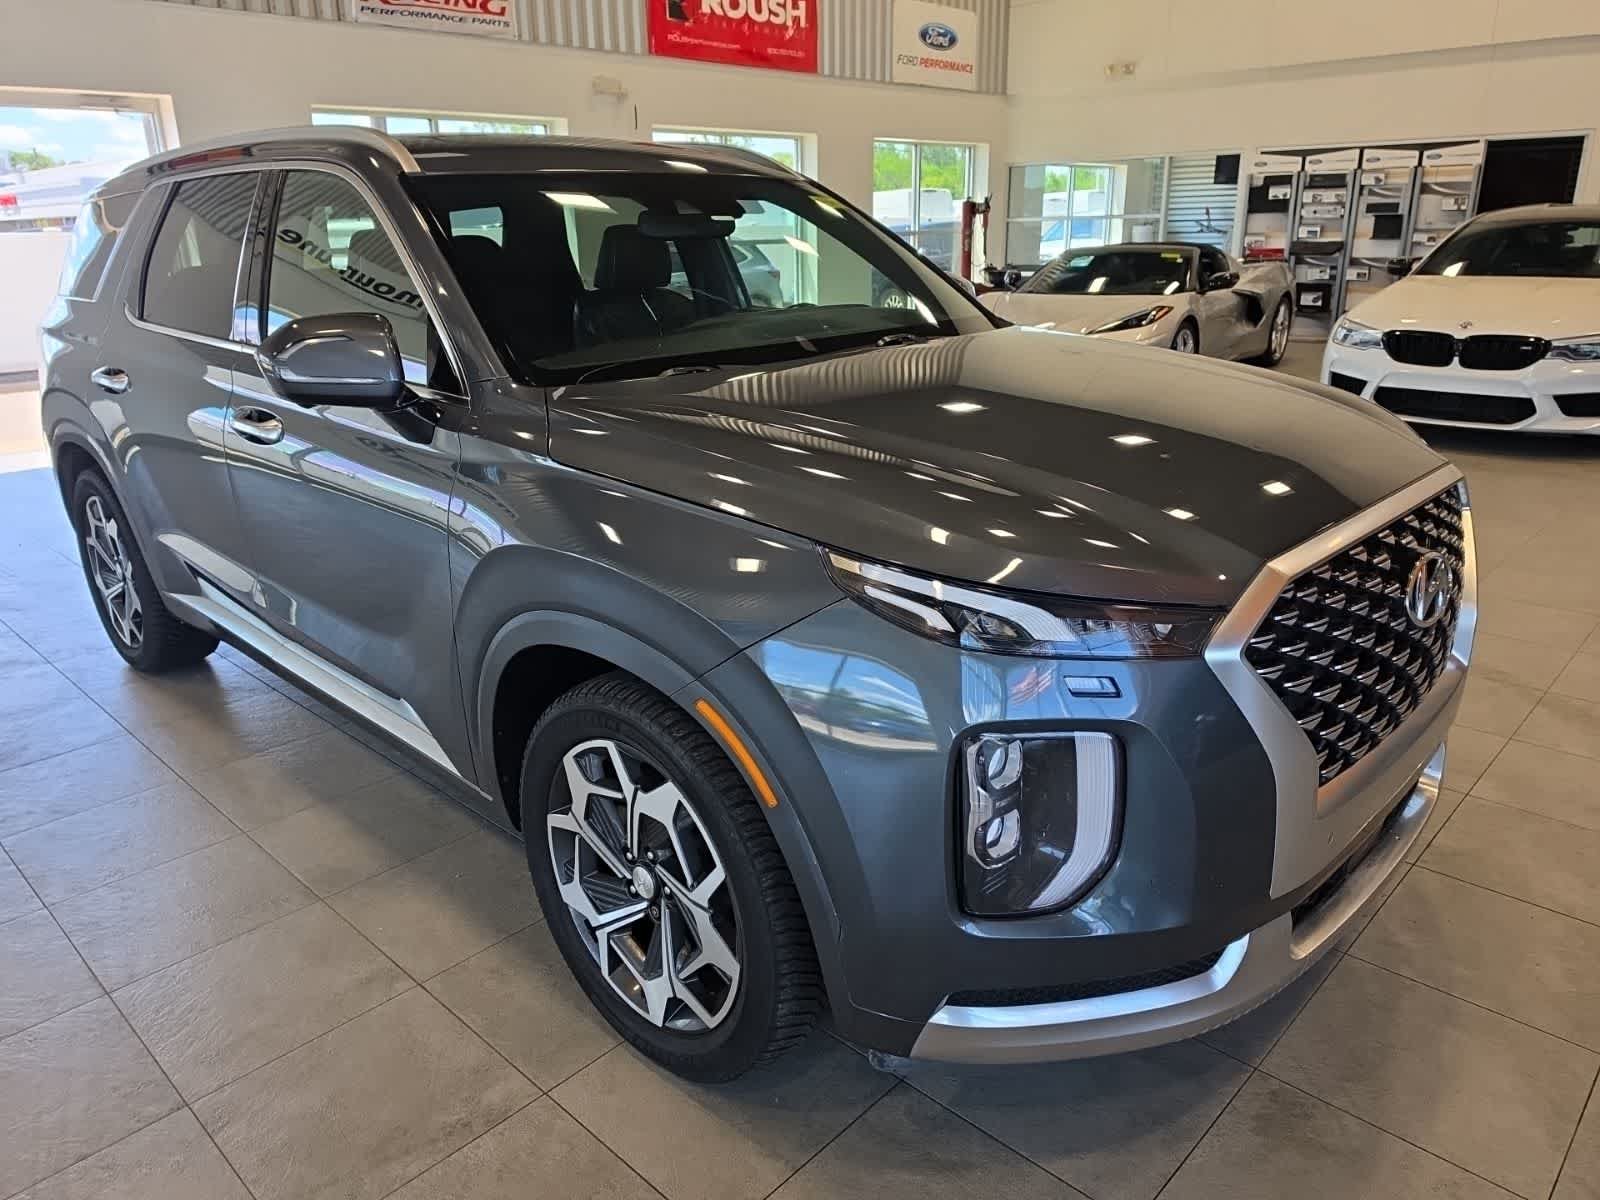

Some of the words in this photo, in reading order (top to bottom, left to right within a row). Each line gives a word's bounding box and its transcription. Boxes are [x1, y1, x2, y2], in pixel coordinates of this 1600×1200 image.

[360, 5, 466, 24] PERFORMANCE
[471, 17, 511, 28] PARTS
[925, 26, 951, 47] Ford
[896, 54, 919, 67] FORD
[919, 57, 974, 74] PERFORMANCE
